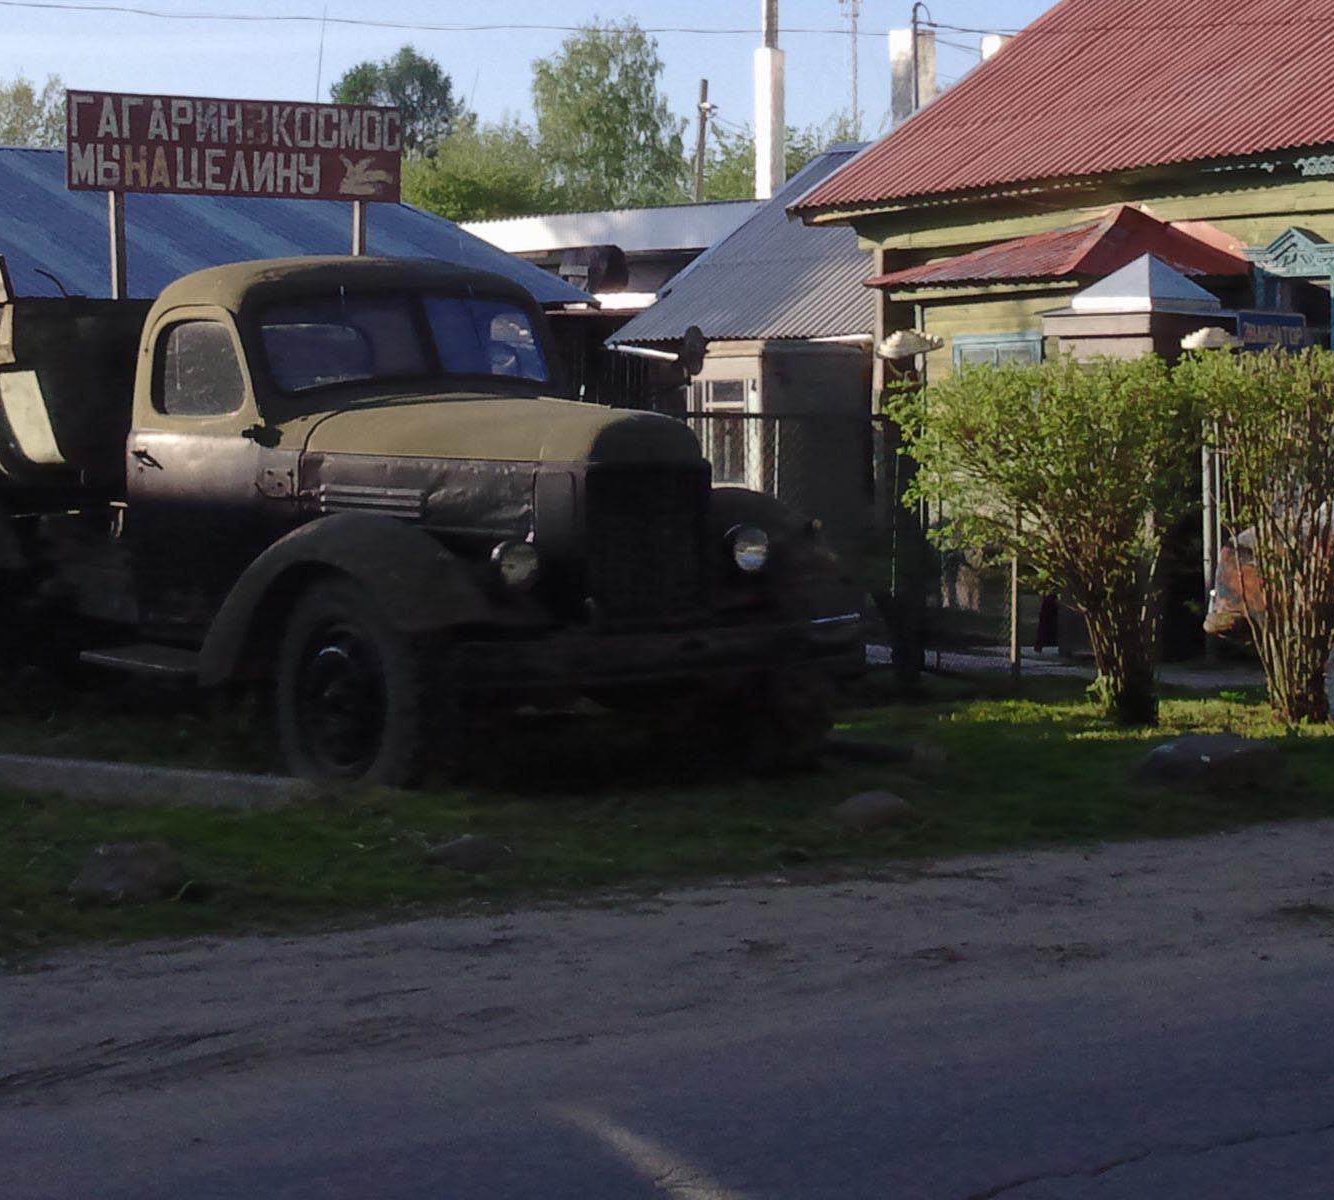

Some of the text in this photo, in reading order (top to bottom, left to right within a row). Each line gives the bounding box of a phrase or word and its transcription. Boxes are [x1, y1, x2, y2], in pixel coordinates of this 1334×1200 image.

[71, 94, 244, 145] ГАГАРИН
[271, 104, 401, 152] КОСМОС
[71, 142, 321, 195] МЫ НА ЦЕЛИНУ
